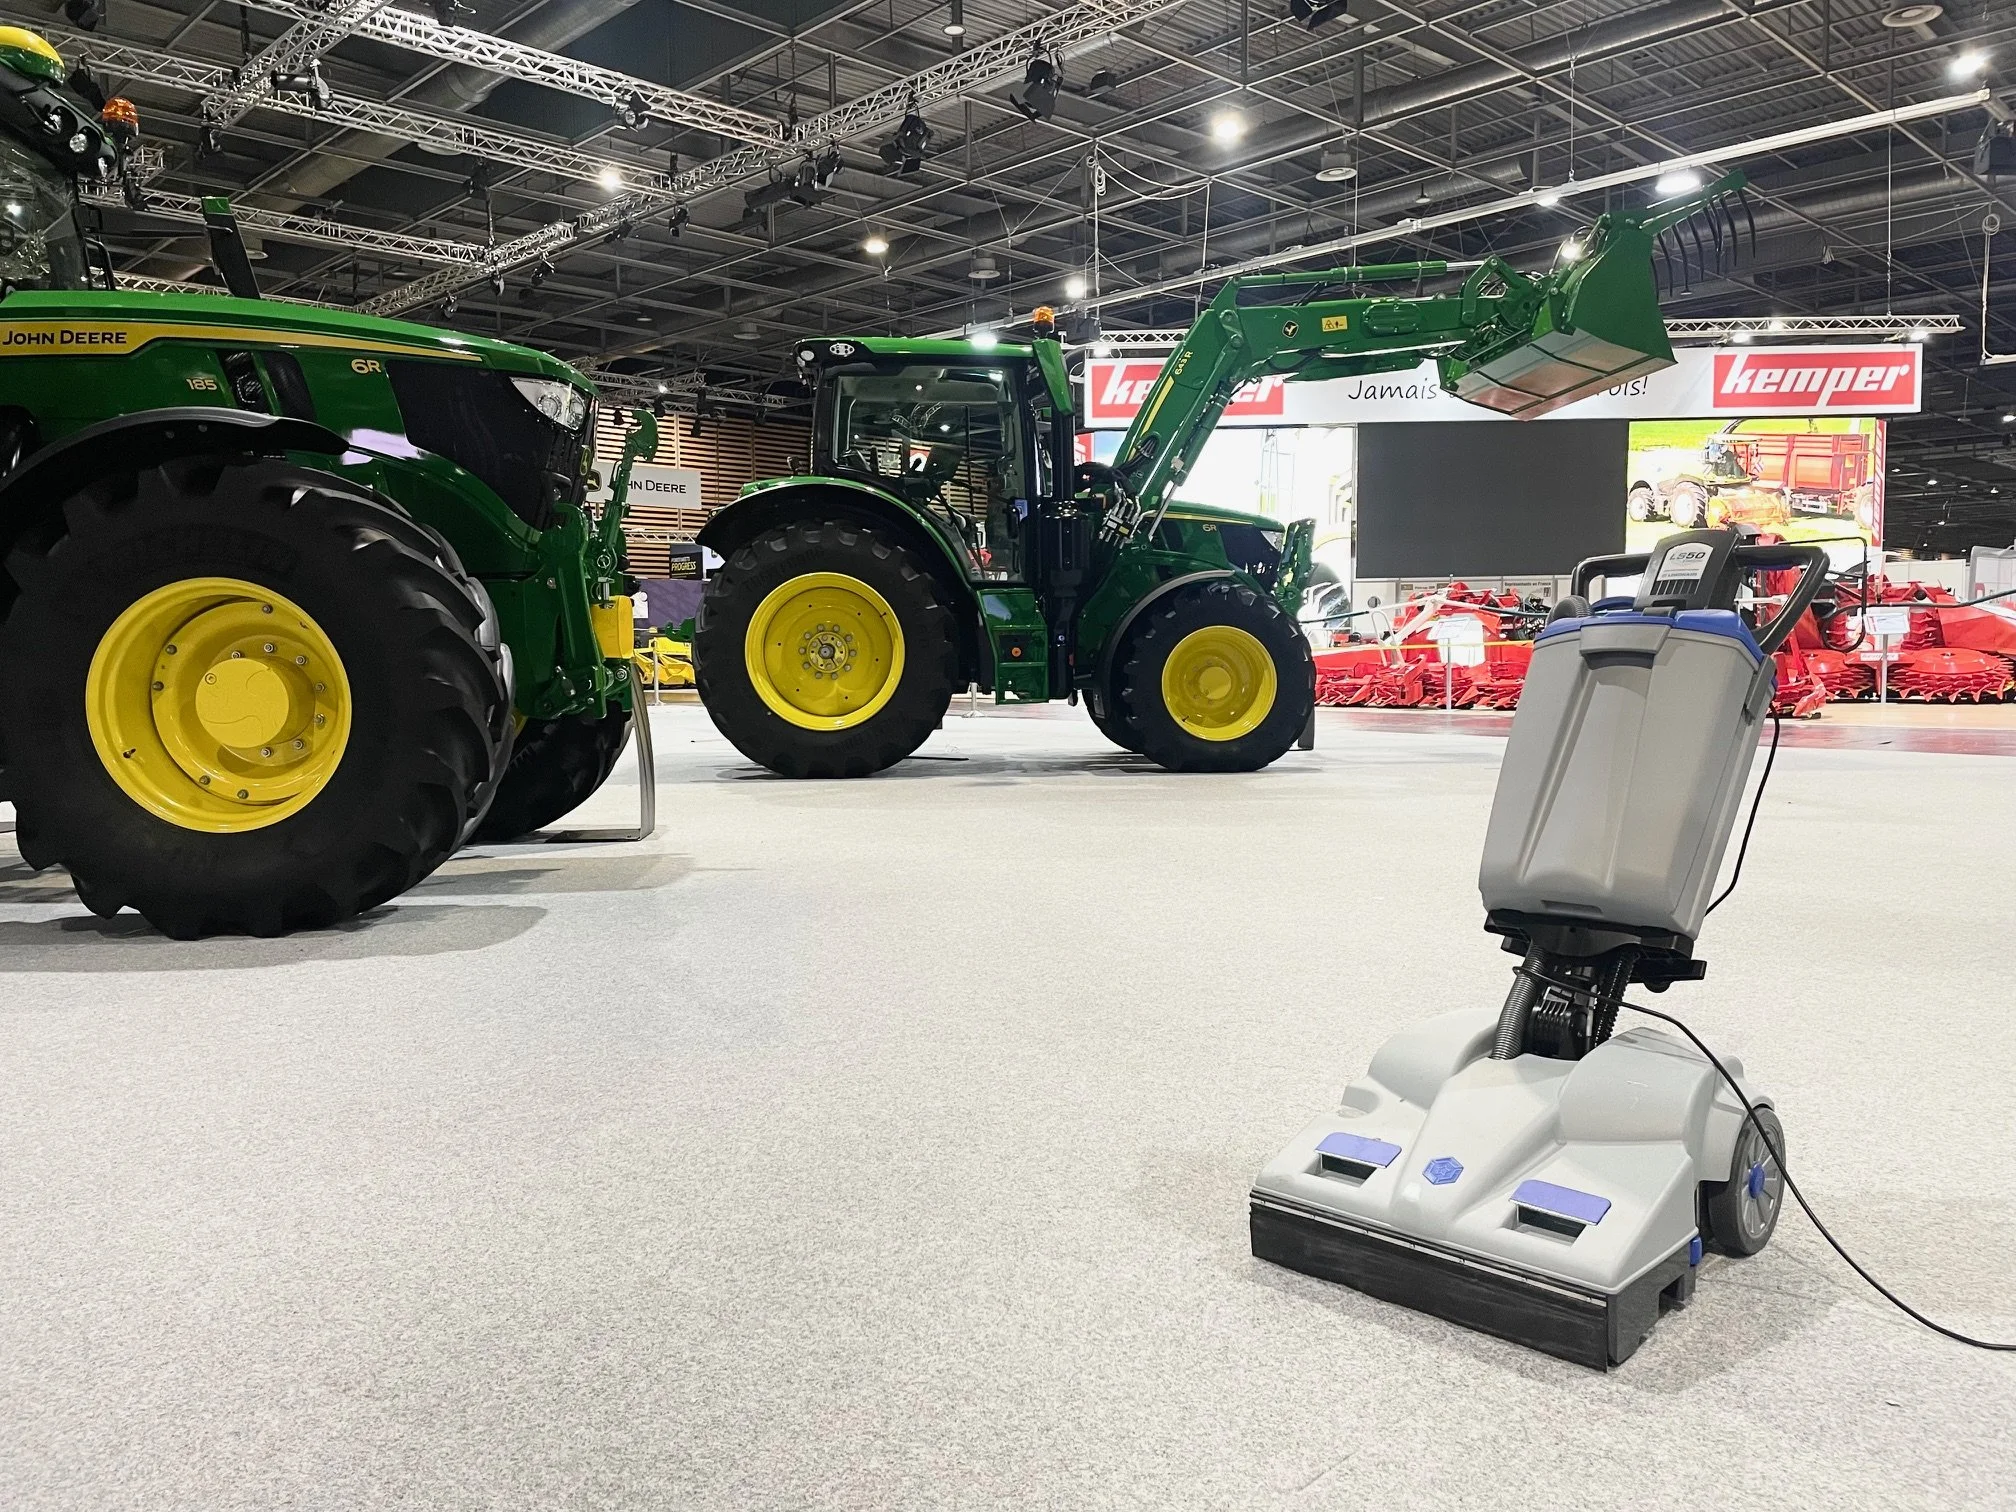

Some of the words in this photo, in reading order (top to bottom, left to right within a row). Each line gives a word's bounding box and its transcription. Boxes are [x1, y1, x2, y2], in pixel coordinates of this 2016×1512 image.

[2, 330, 55, 345] JOHN
[60, 329, 127, 344] DEERE
[350, 358, 382, 374] 6R
[186, 378, 218, 391] 185
[1347, 377, 1438, 400] Jamais
[1720, 354, 1911, 407] kemper
[645, 479, 687, 494] DEERE
[671, 561, 697, 571] PROGRESS
